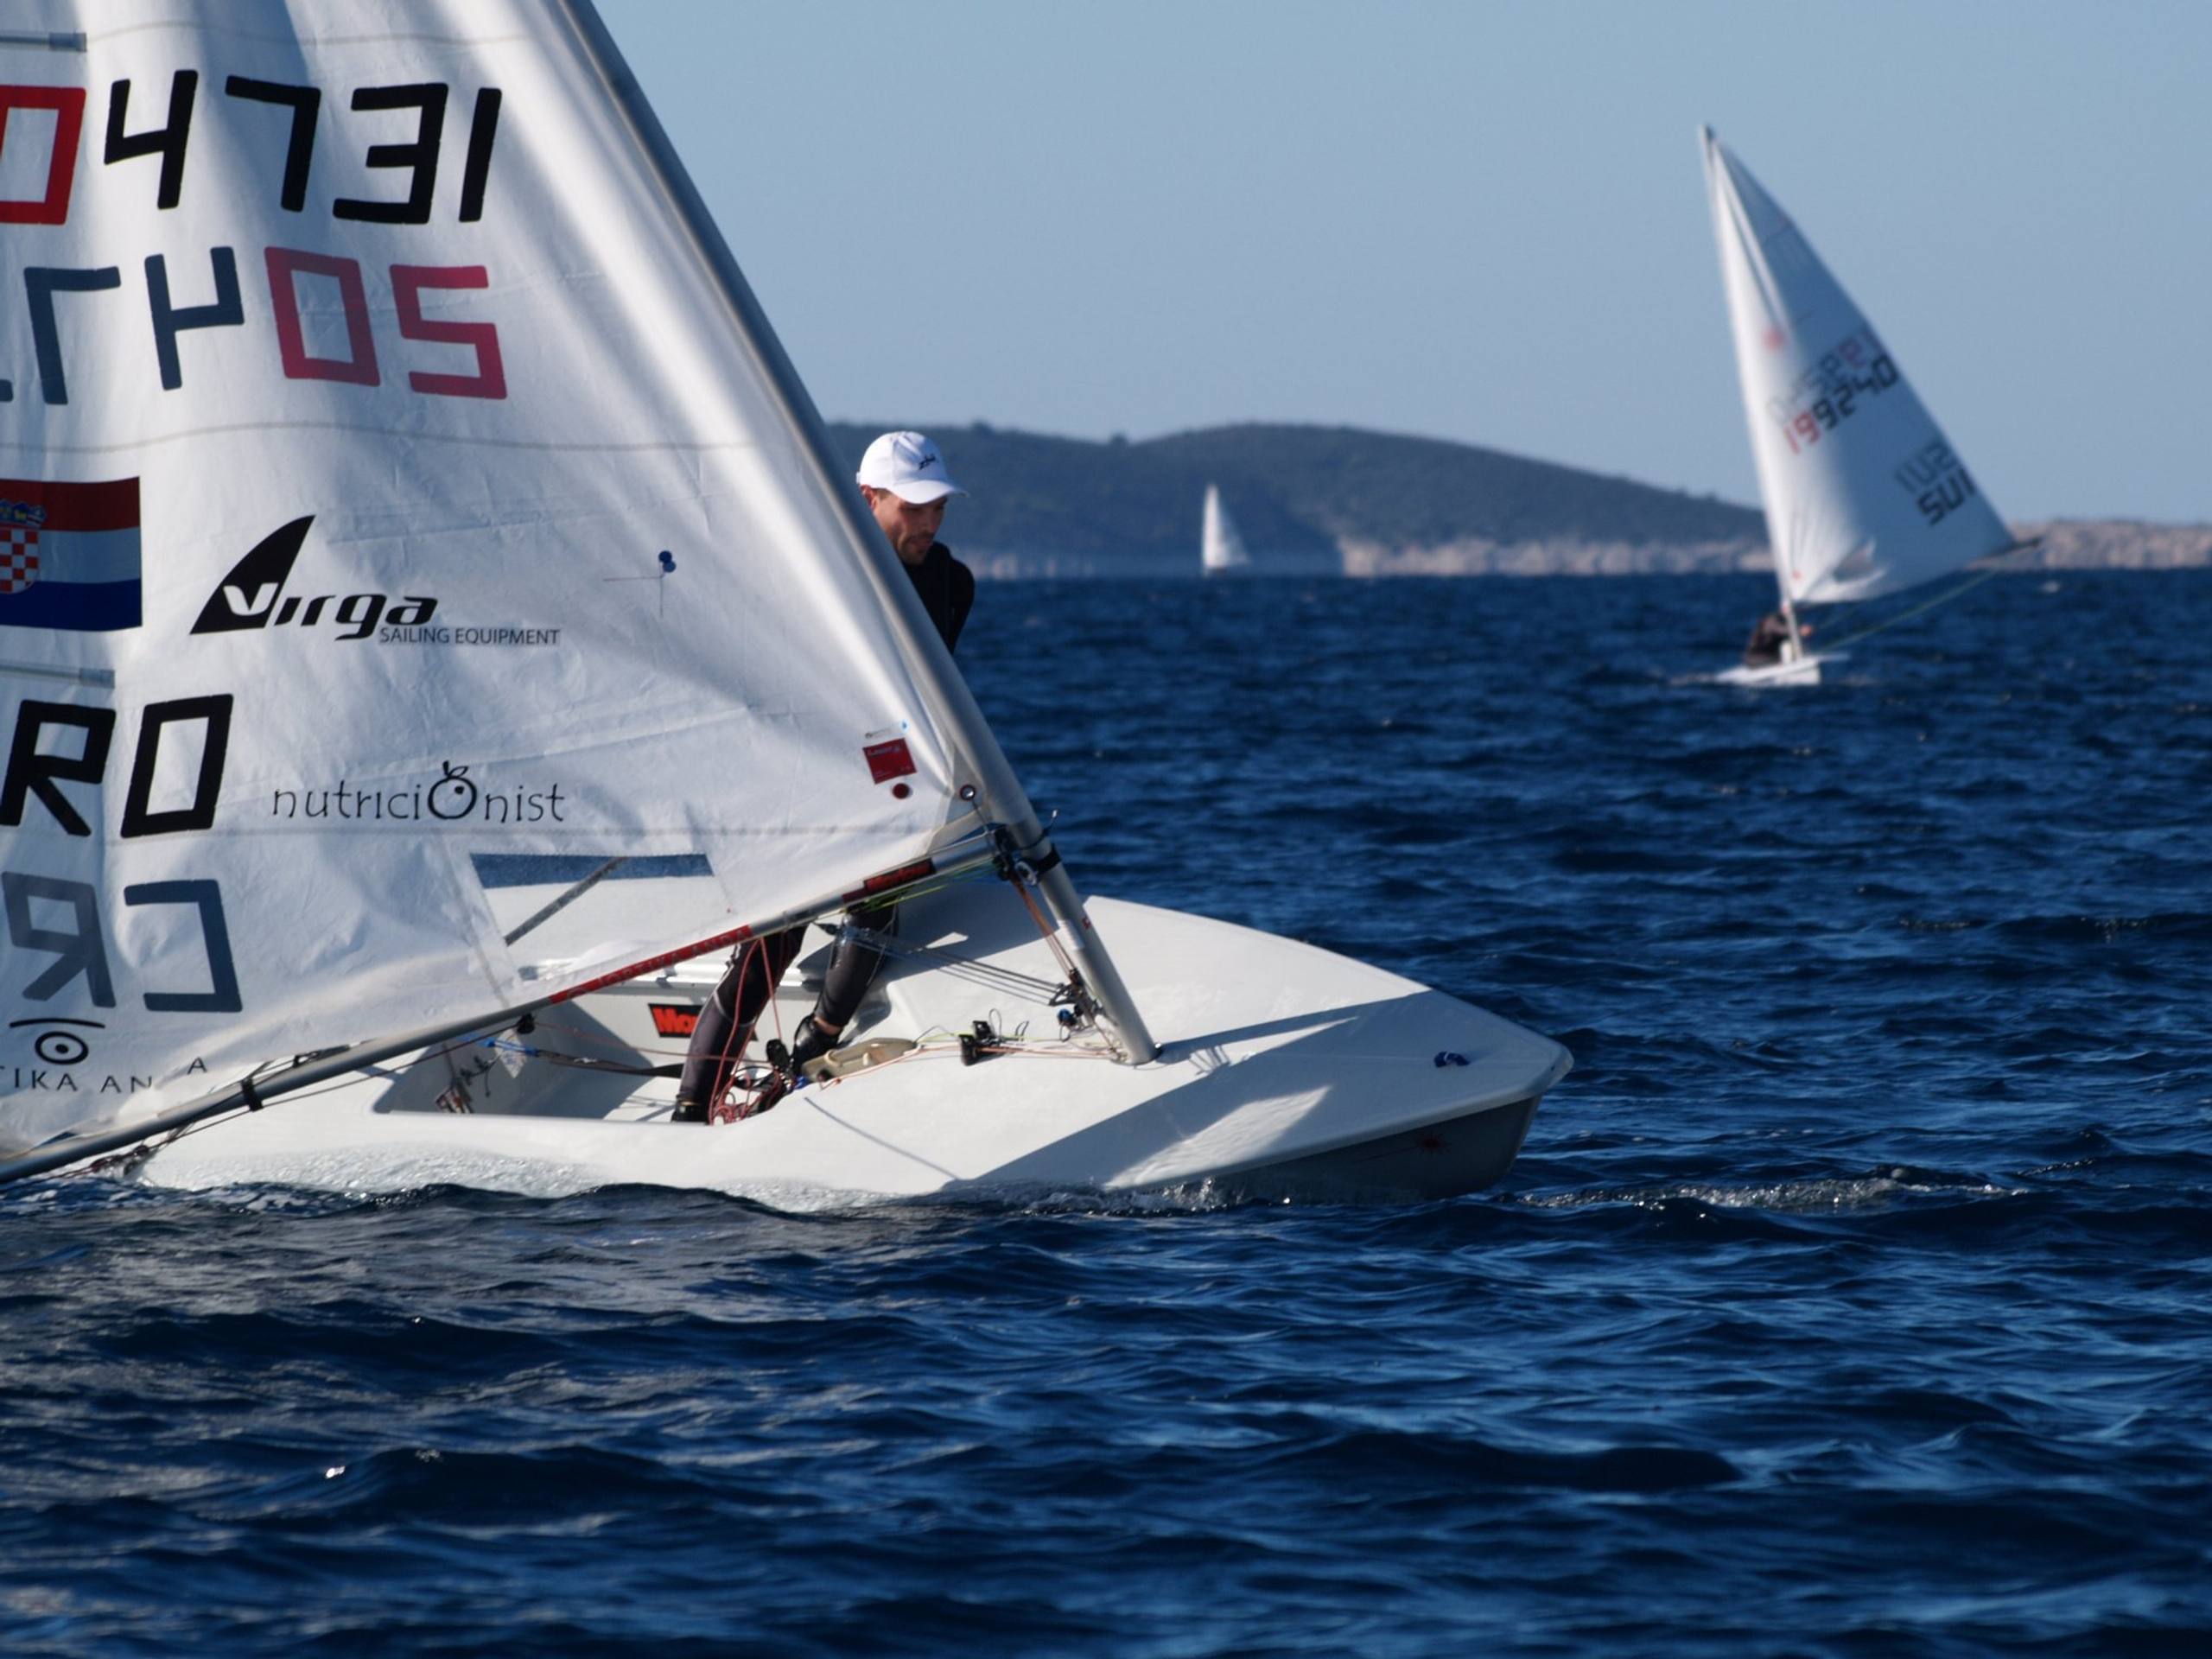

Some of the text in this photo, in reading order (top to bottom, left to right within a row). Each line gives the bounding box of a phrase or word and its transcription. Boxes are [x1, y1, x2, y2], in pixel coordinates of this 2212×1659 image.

[1783, 353, 1900, 455] 199240
[1916, 467, 1976, 527] SUI
[378, 626, 561, 645] SAILING EQUIPMENT
